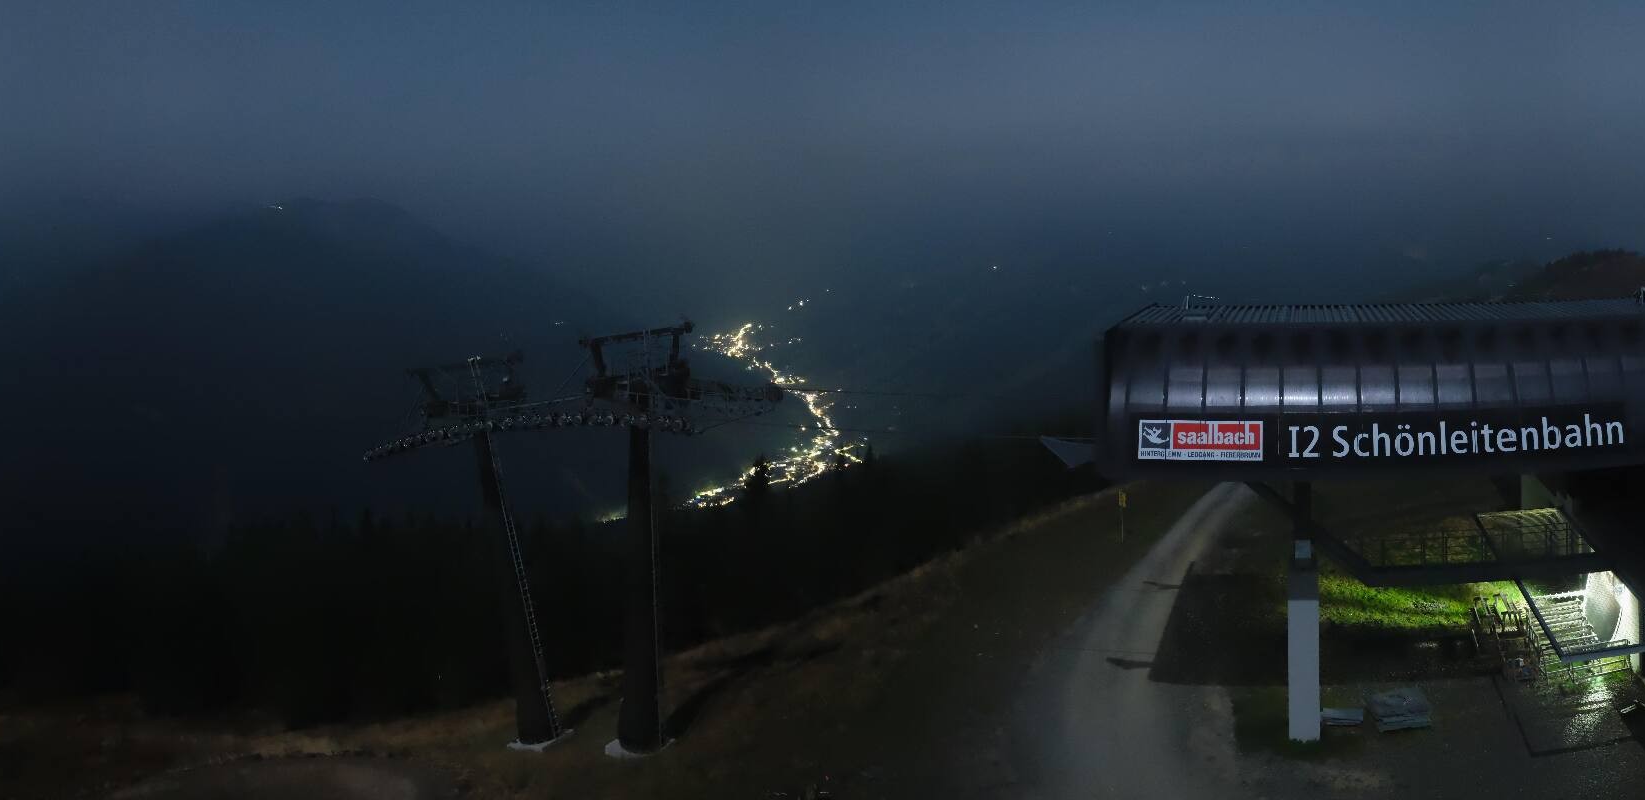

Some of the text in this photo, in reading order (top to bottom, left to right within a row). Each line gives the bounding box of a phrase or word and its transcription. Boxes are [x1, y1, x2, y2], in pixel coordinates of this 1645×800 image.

[1177, 423, 1255, 445] saalbach
[1288, 413, 1624, 458] I2 Schönleitenbahn
